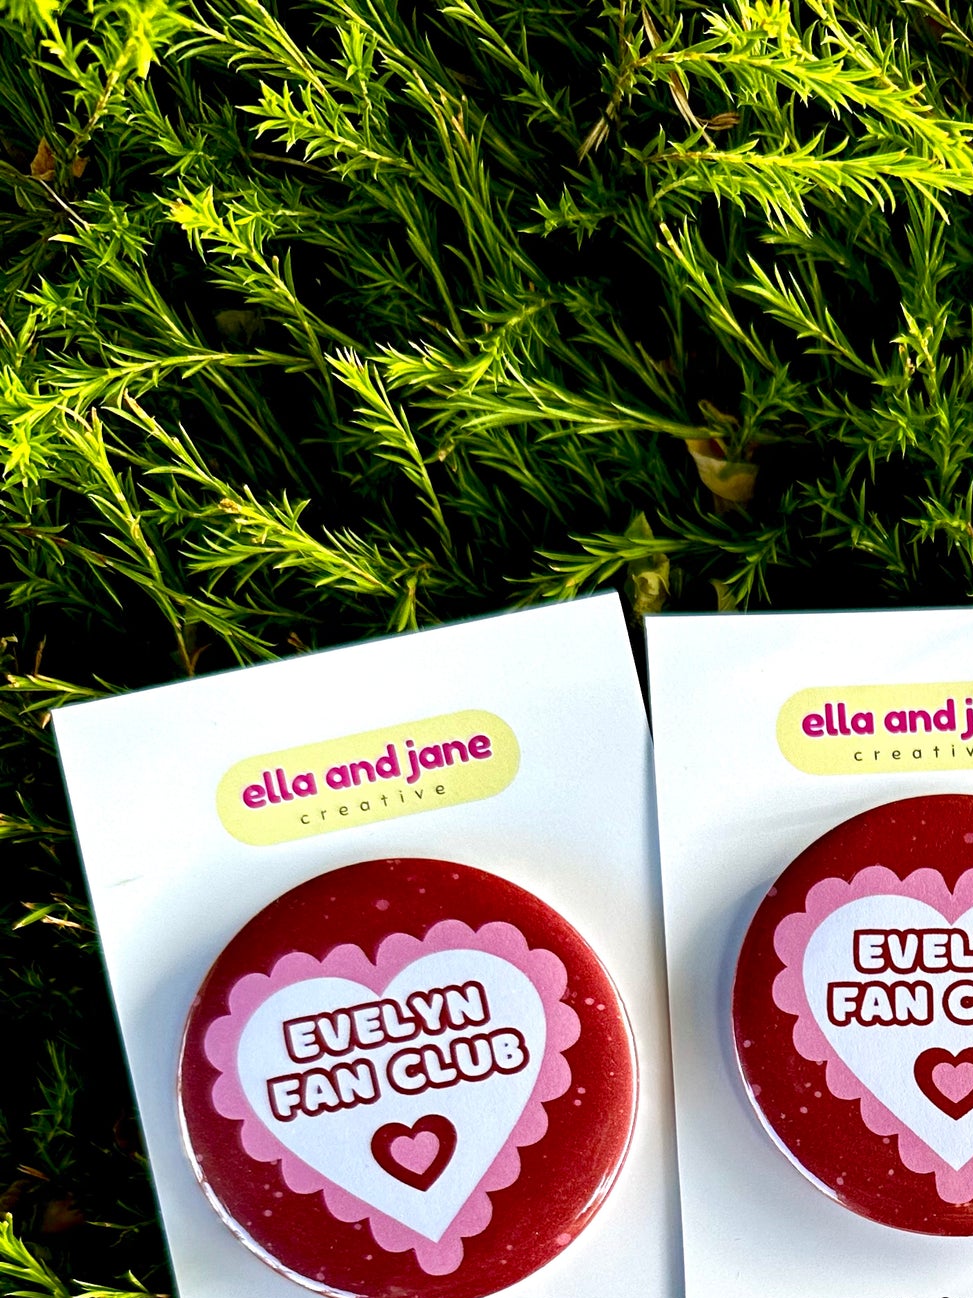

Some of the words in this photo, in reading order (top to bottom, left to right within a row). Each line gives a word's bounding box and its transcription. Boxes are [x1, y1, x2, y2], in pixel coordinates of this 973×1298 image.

[800, 702, 876, 738] ella
[882, 697, 957, 734] and
[241, 764, 318, 810] ella
[324, 743, 401, 790] and
[404, 732, 494, 785] jane
[299, 783, 447, 826] creative
[283, 980, 491, 1063] EVELYN
[826, 980, 934, 1027] FAN
[266, 1058, 379, 1122] FAN
[386, 1027, 530, 1096] CLUB
